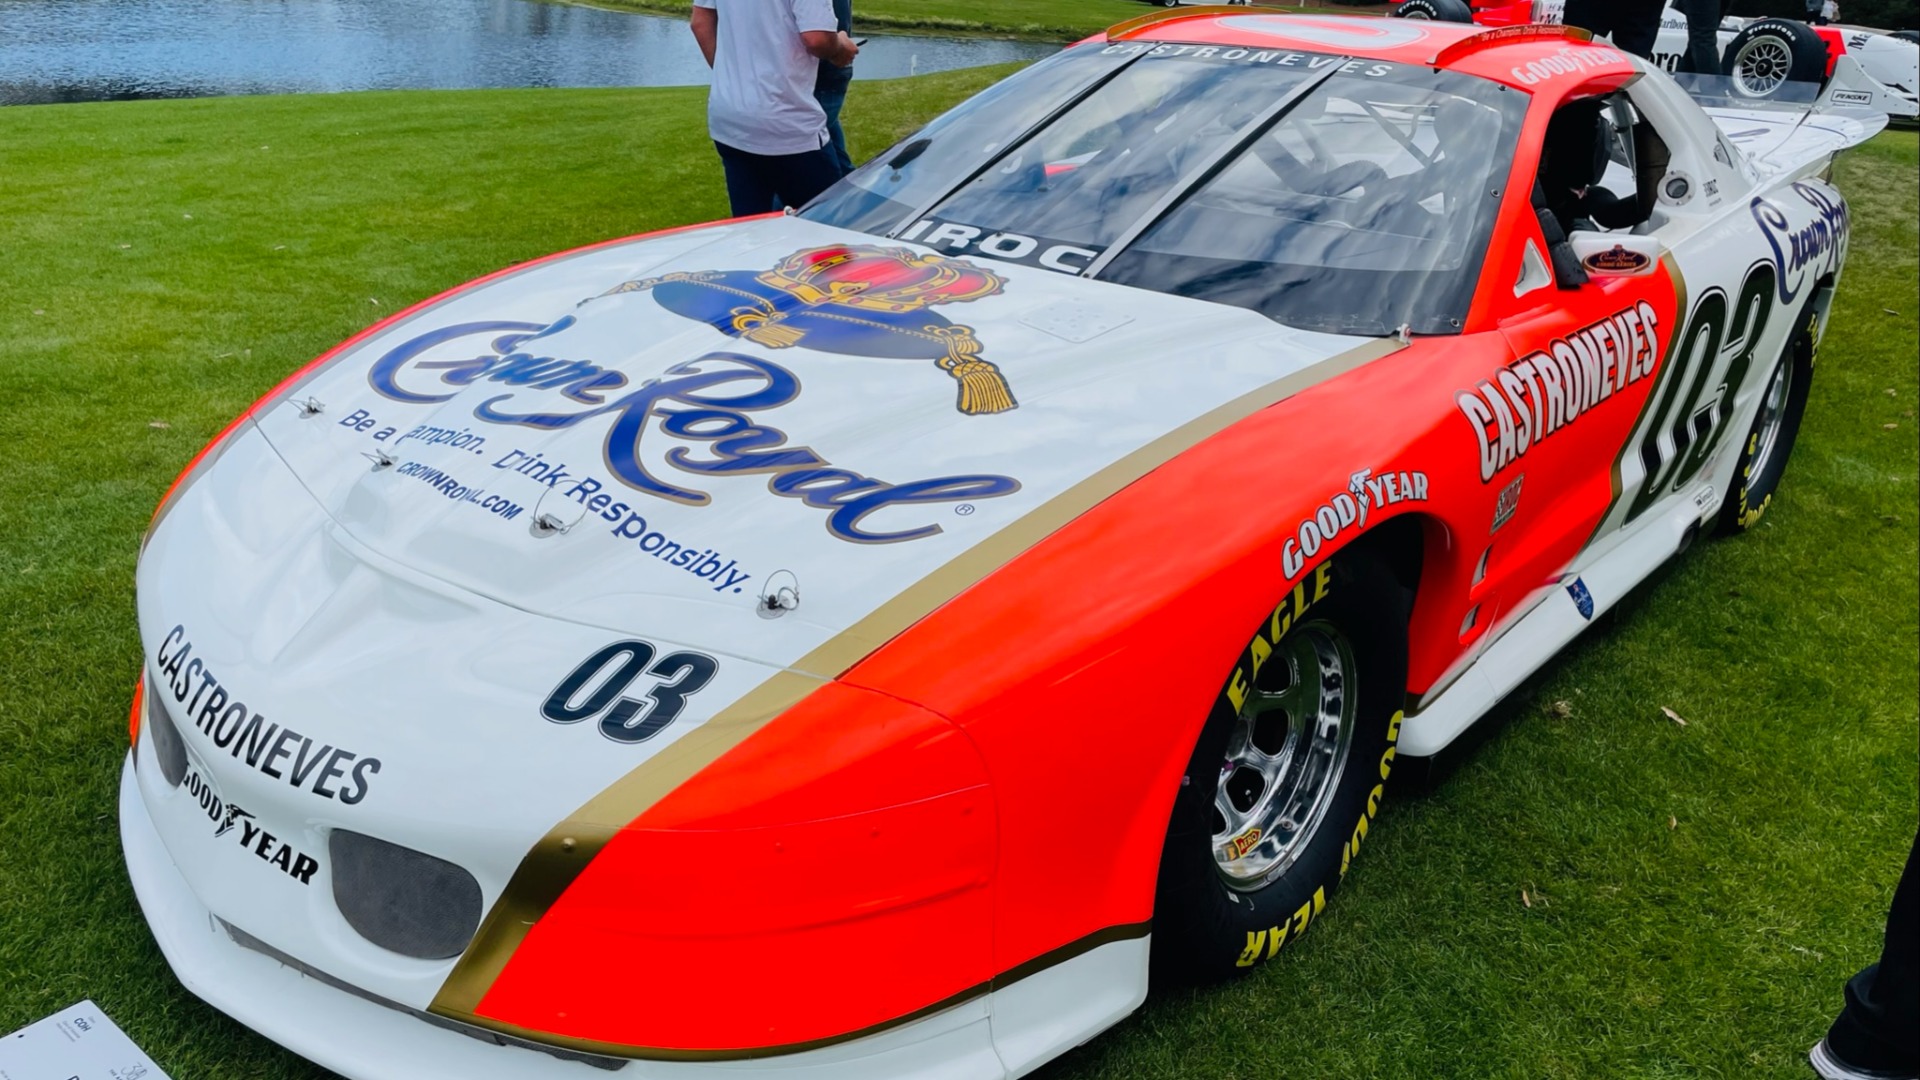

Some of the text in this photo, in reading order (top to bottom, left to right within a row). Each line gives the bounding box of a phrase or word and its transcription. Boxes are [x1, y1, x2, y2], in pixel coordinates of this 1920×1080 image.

[1101, 41, 1393, 78] CASTRONEVES
[1398, 0, 1437, 17] Firestone
[1748, 24, 1796, 42] Firestone
[1511, 48, 1626, 85] GOODYEAR
[1835, 93, 1868, 101] PENSKE
[900, 219, 1098, 275] IROC
[1454, 299, 1658, 484] CASTRONEVES
[1622, 257, 1776, 528] 03
[338, 408, 376, 432] Be
[373, 426, 397, 442] a
[395, 424, 486, 454] ampion.
[564, 476, 752, 594] Responsibly.
[473, 351, 1022, 545] Royal
[1282, 467, 1429, 580] GOODYEAR
[540, 638, 719, 744] 03
[1227, 560, 1332, 716] EAGLE
[157, 624, 382, 805] CASTRONEVES
[1240, 832, 1257, 850] AERO
